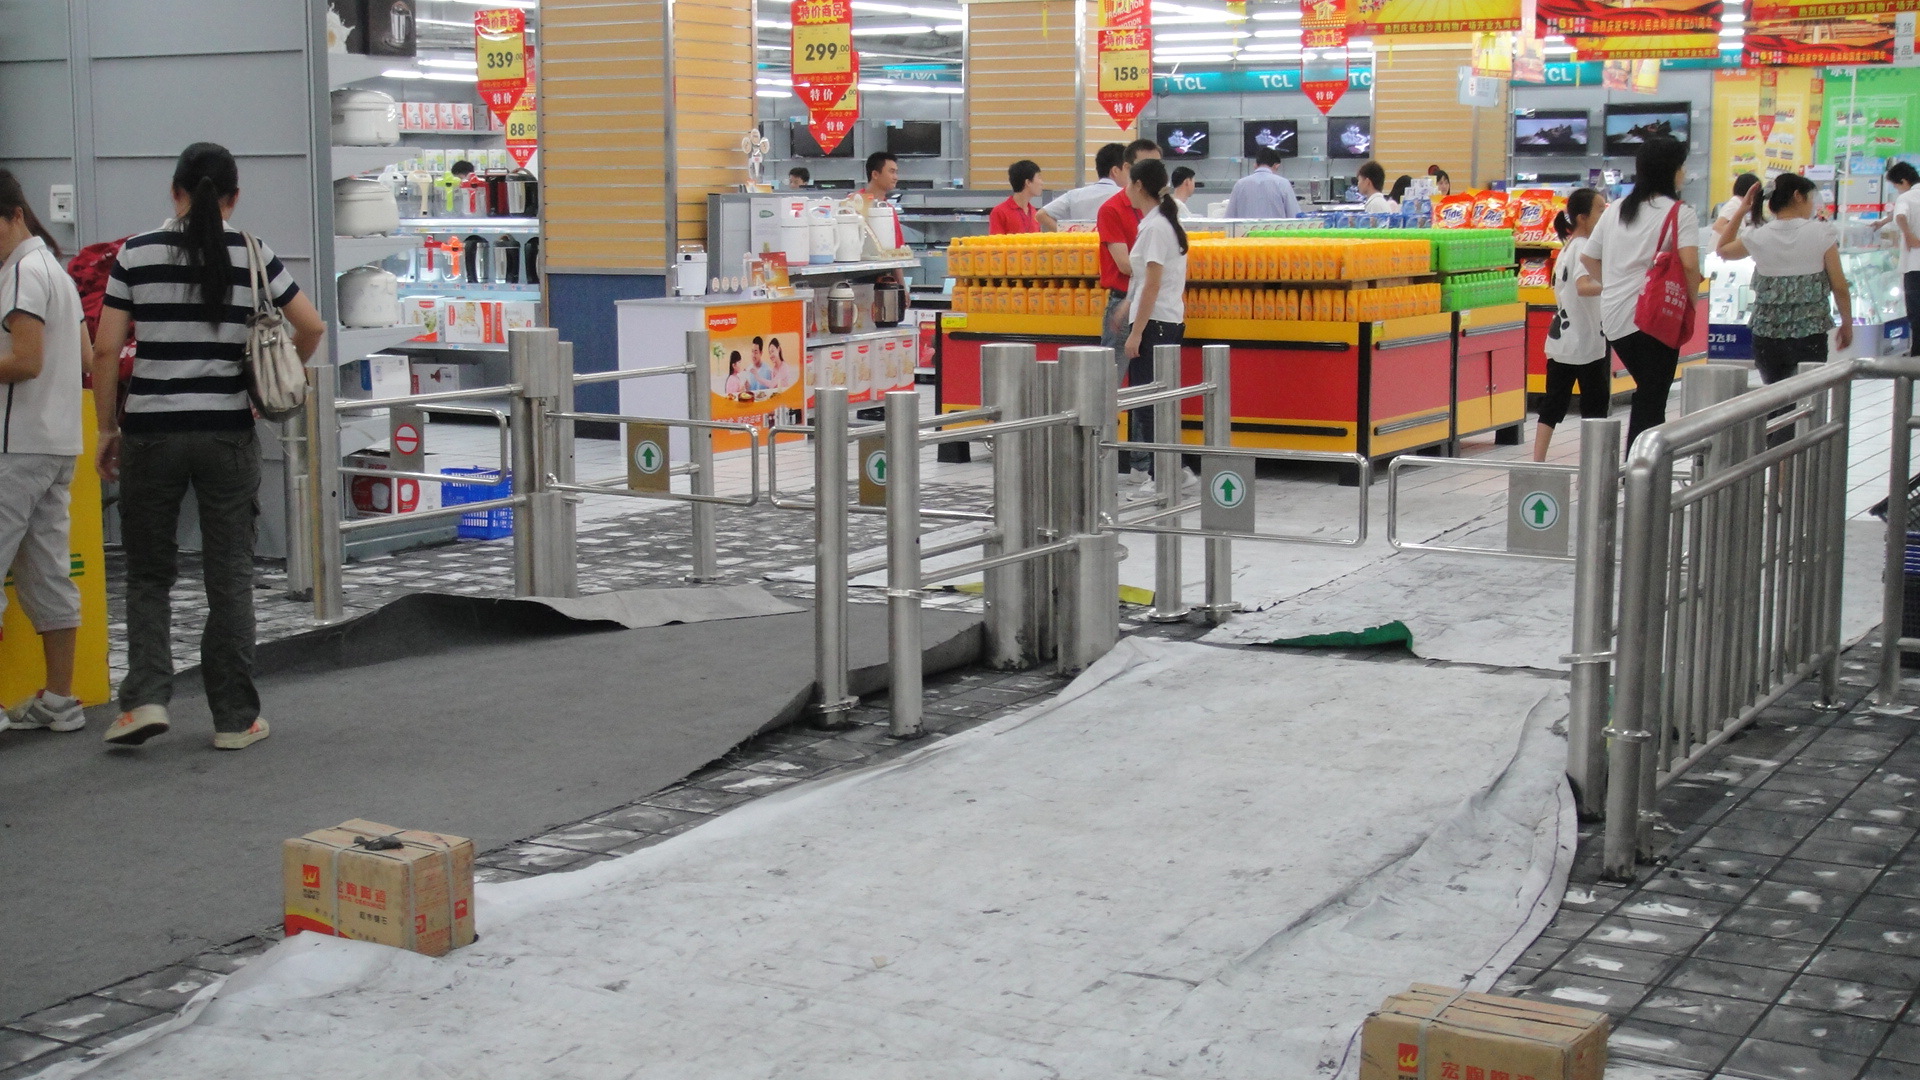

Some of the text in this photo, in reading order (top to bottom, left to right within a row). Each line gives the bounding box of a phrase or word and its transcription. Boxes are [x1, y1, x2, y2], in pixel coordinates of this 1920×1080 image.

[800, 3, 843, 19] 特价商品
[1349, 72, 1371, 86] TC
[1544, 67, 1572, 81] CL
[1173, 77, 1206, 90] TCL
[1259, 75, 1293, 88] TCL
[493, 92, 512, 104] 特价
[810, 89, 833, 101] 特价
[1114, 102, 1135, 114] 特价
[1442, 208, 1463, 221] Tide
[1521, 204, 1541, 219] Tide
[1523, 230, 1544, 242] 215
